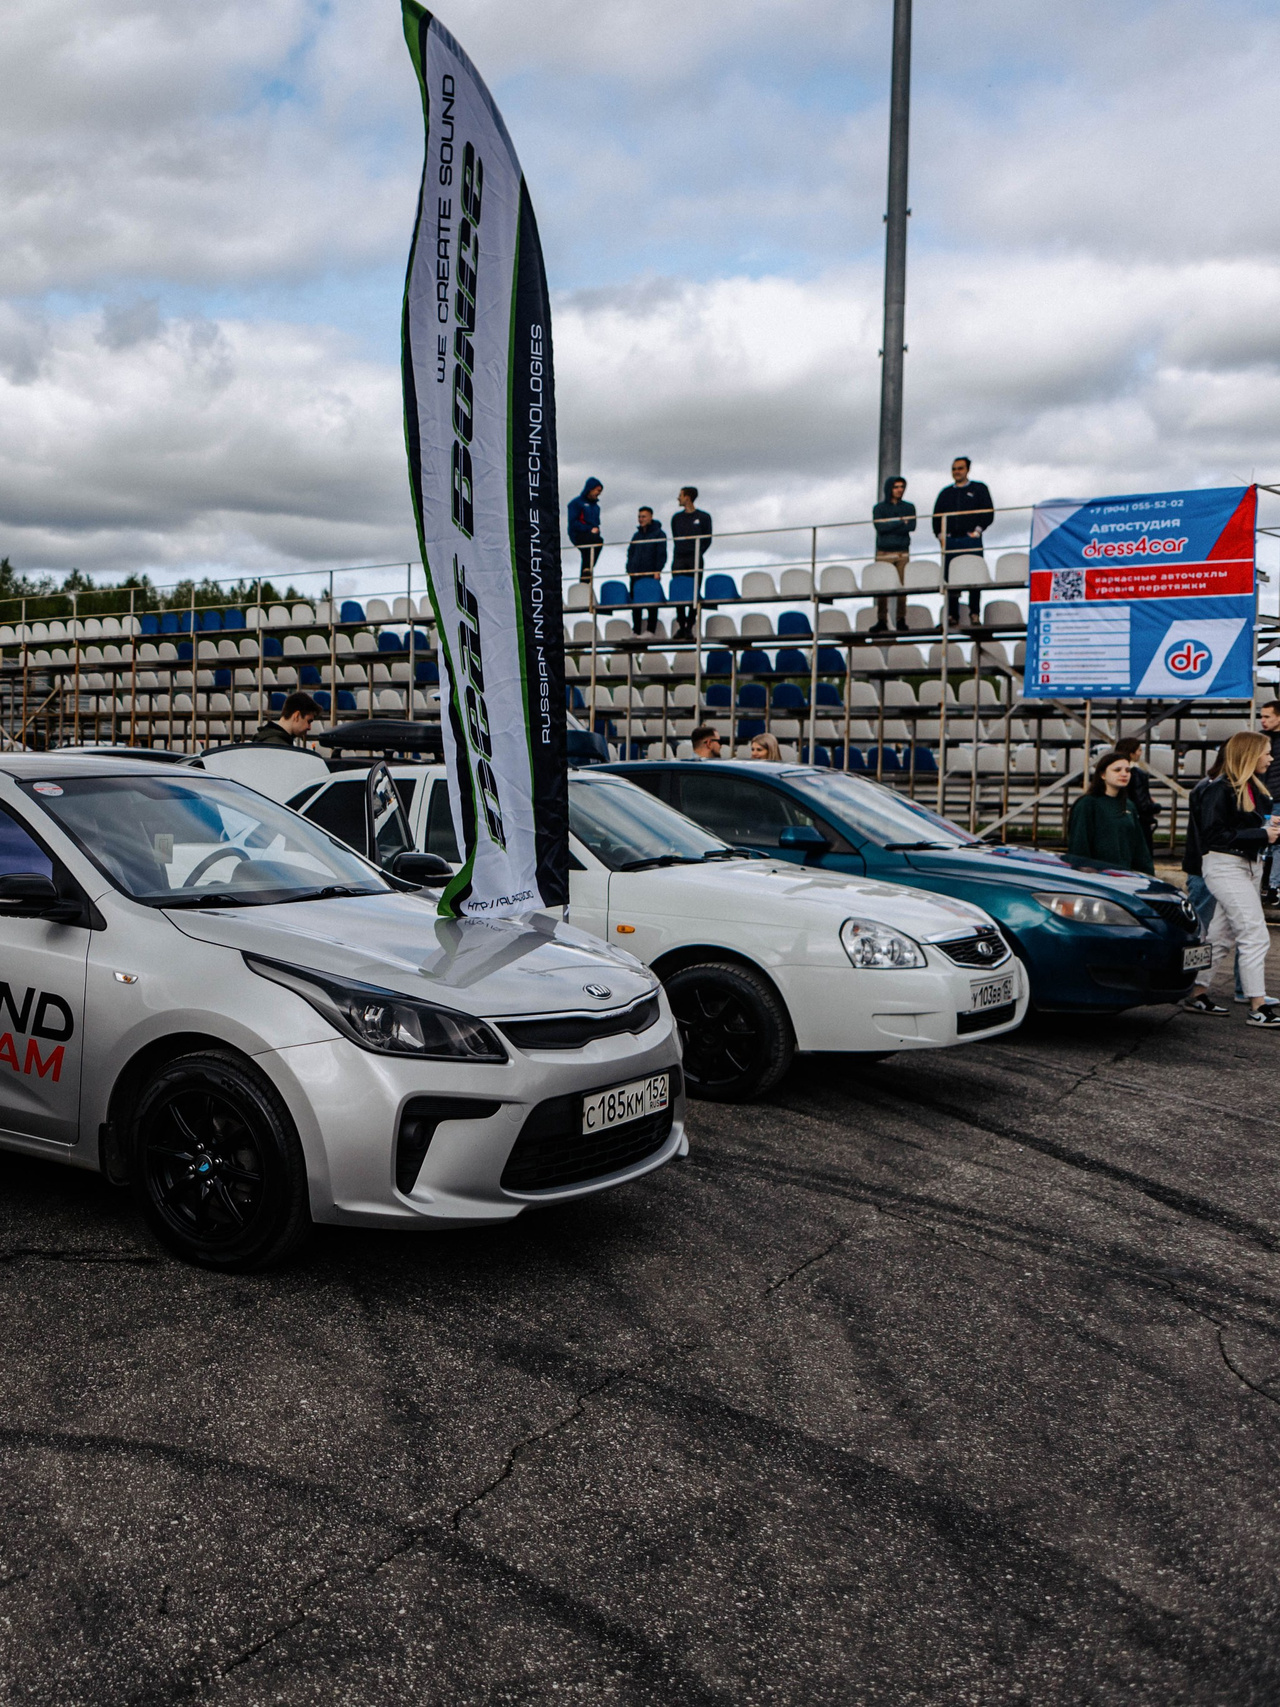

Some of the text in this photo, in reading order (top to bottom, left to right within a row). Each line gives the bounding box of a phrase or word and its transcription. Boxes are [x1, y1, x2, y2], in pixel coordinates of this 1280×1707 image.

[436, 74, 456, 383] WE CREATE SOUND
[1131, 499, 1185, 511] 055-52-02
[528, 323, 550, 744] RUSSIAN INNOVATIVE TECHNOLOGIES
[1089, 518, 1181, 534] Автостудия
[1083, 535, 1188, 558] dress4car
[1095, 571, 1228, 584] каркасные авточехлы
[1138, 583, 1207, 593] перетяжки
[1169, 643, 1207, 672] dr
[586, 1076, 667, 1128] С185КМ 152
[649, 1100, 660, 1110] RUS
